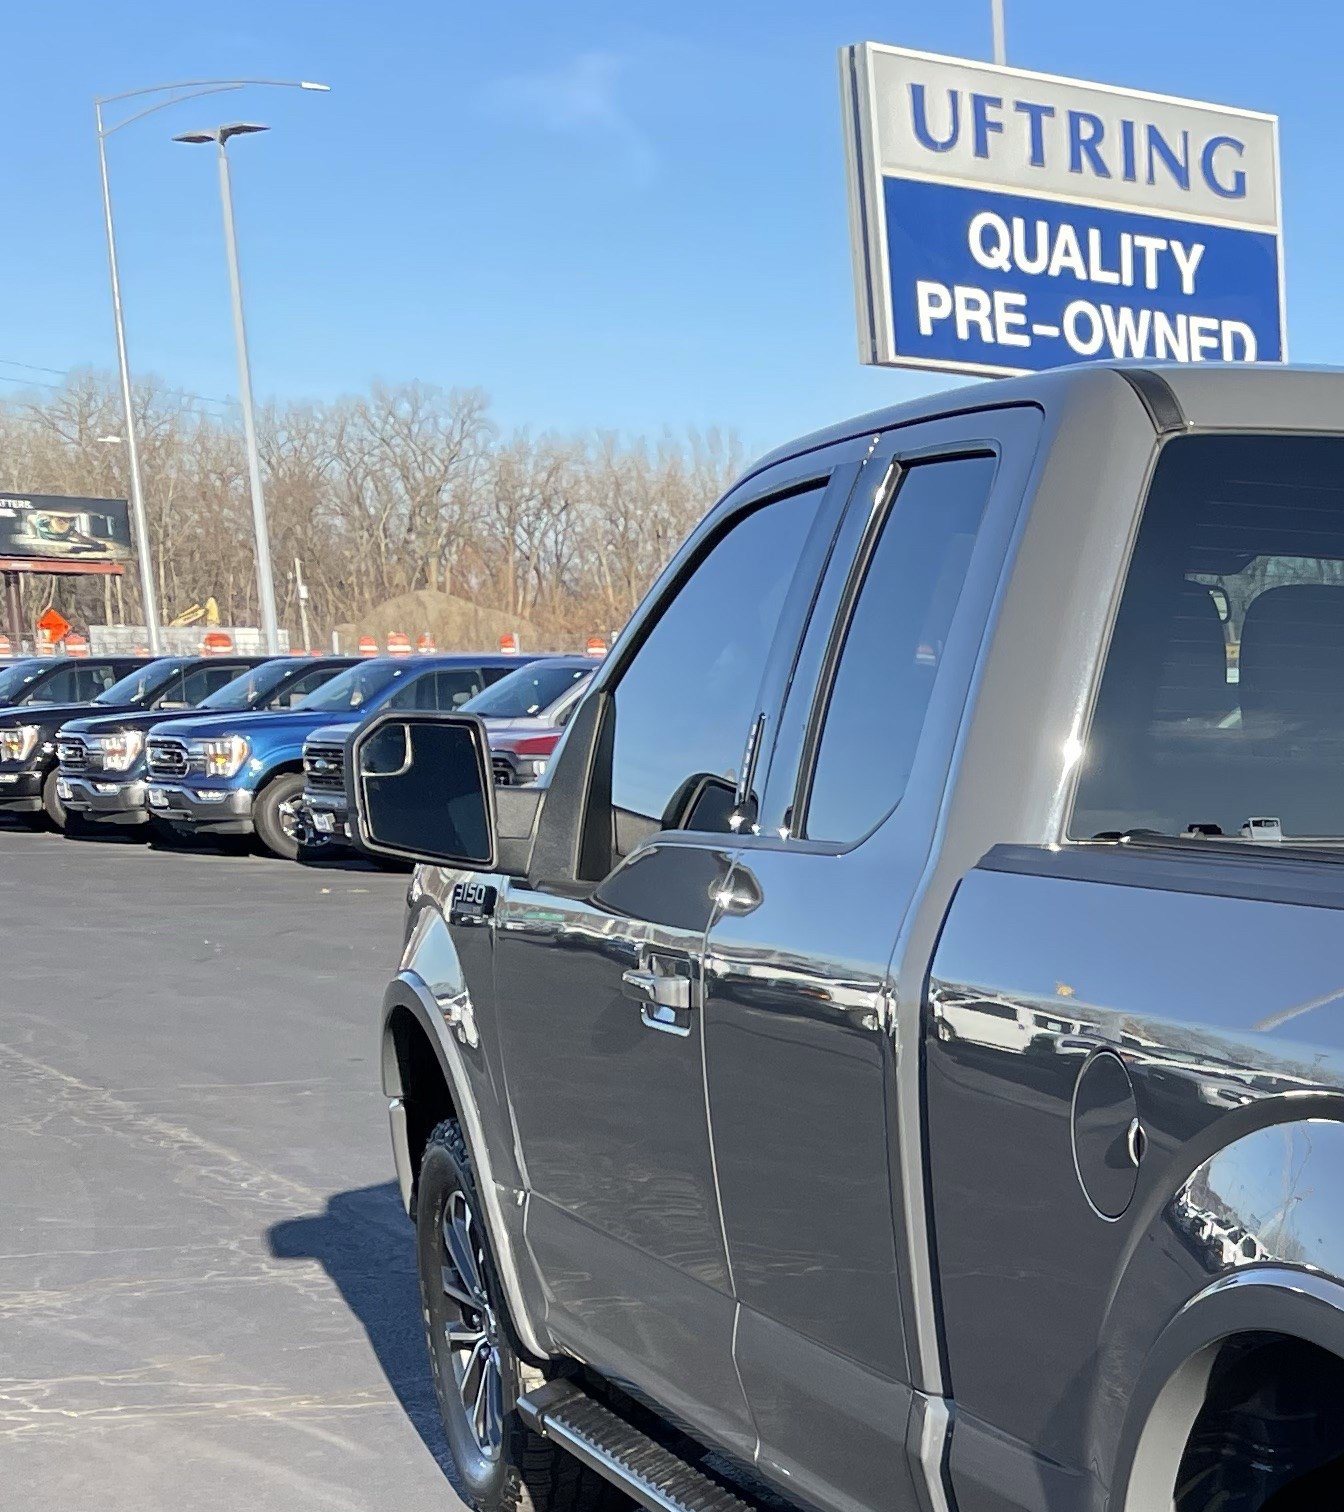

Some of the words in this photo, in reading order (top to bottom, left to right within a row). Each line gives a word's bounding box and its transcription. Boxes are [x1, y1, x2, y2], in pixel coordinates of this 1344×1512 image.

[908, 82, 1247, 200] UFTRING
[967, 211, 1205, 296] QUALITY
[915, 280, 1257, 363] PRE-OWNED
